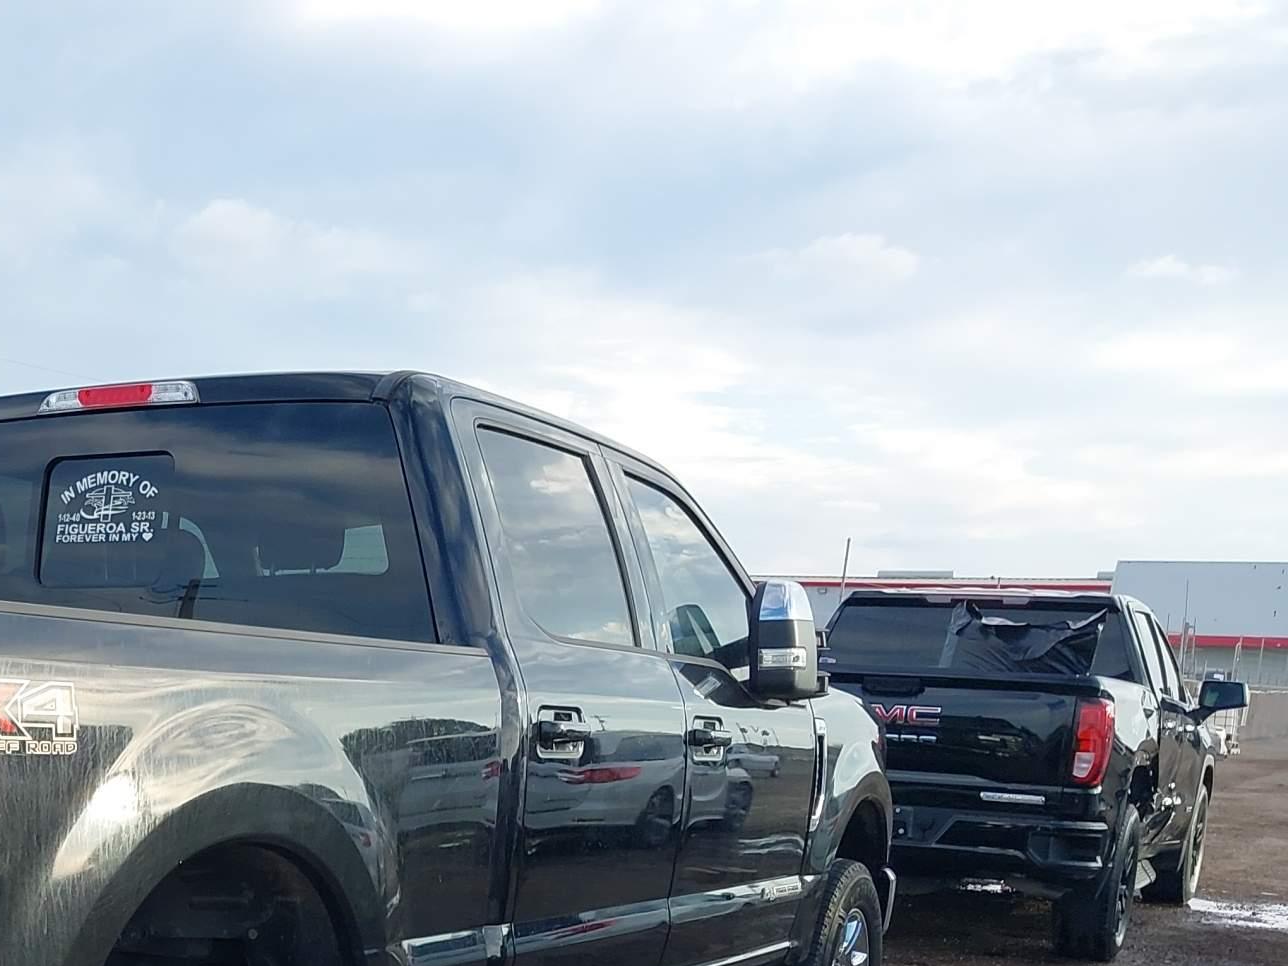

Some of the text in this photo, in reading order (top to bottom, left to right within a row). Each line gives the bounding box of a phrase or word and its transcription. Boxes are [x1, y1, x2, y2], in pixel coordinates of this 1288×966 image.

[61, 470, 158, 504] IN MEMORY OF
[57, 521, 154, 534] FIGUEROA SR.
[56, 532, 139, 543] FOREVER IN MY
[871, 703, 942, 725] MC
[26, 740, 78, 755] ROAD
